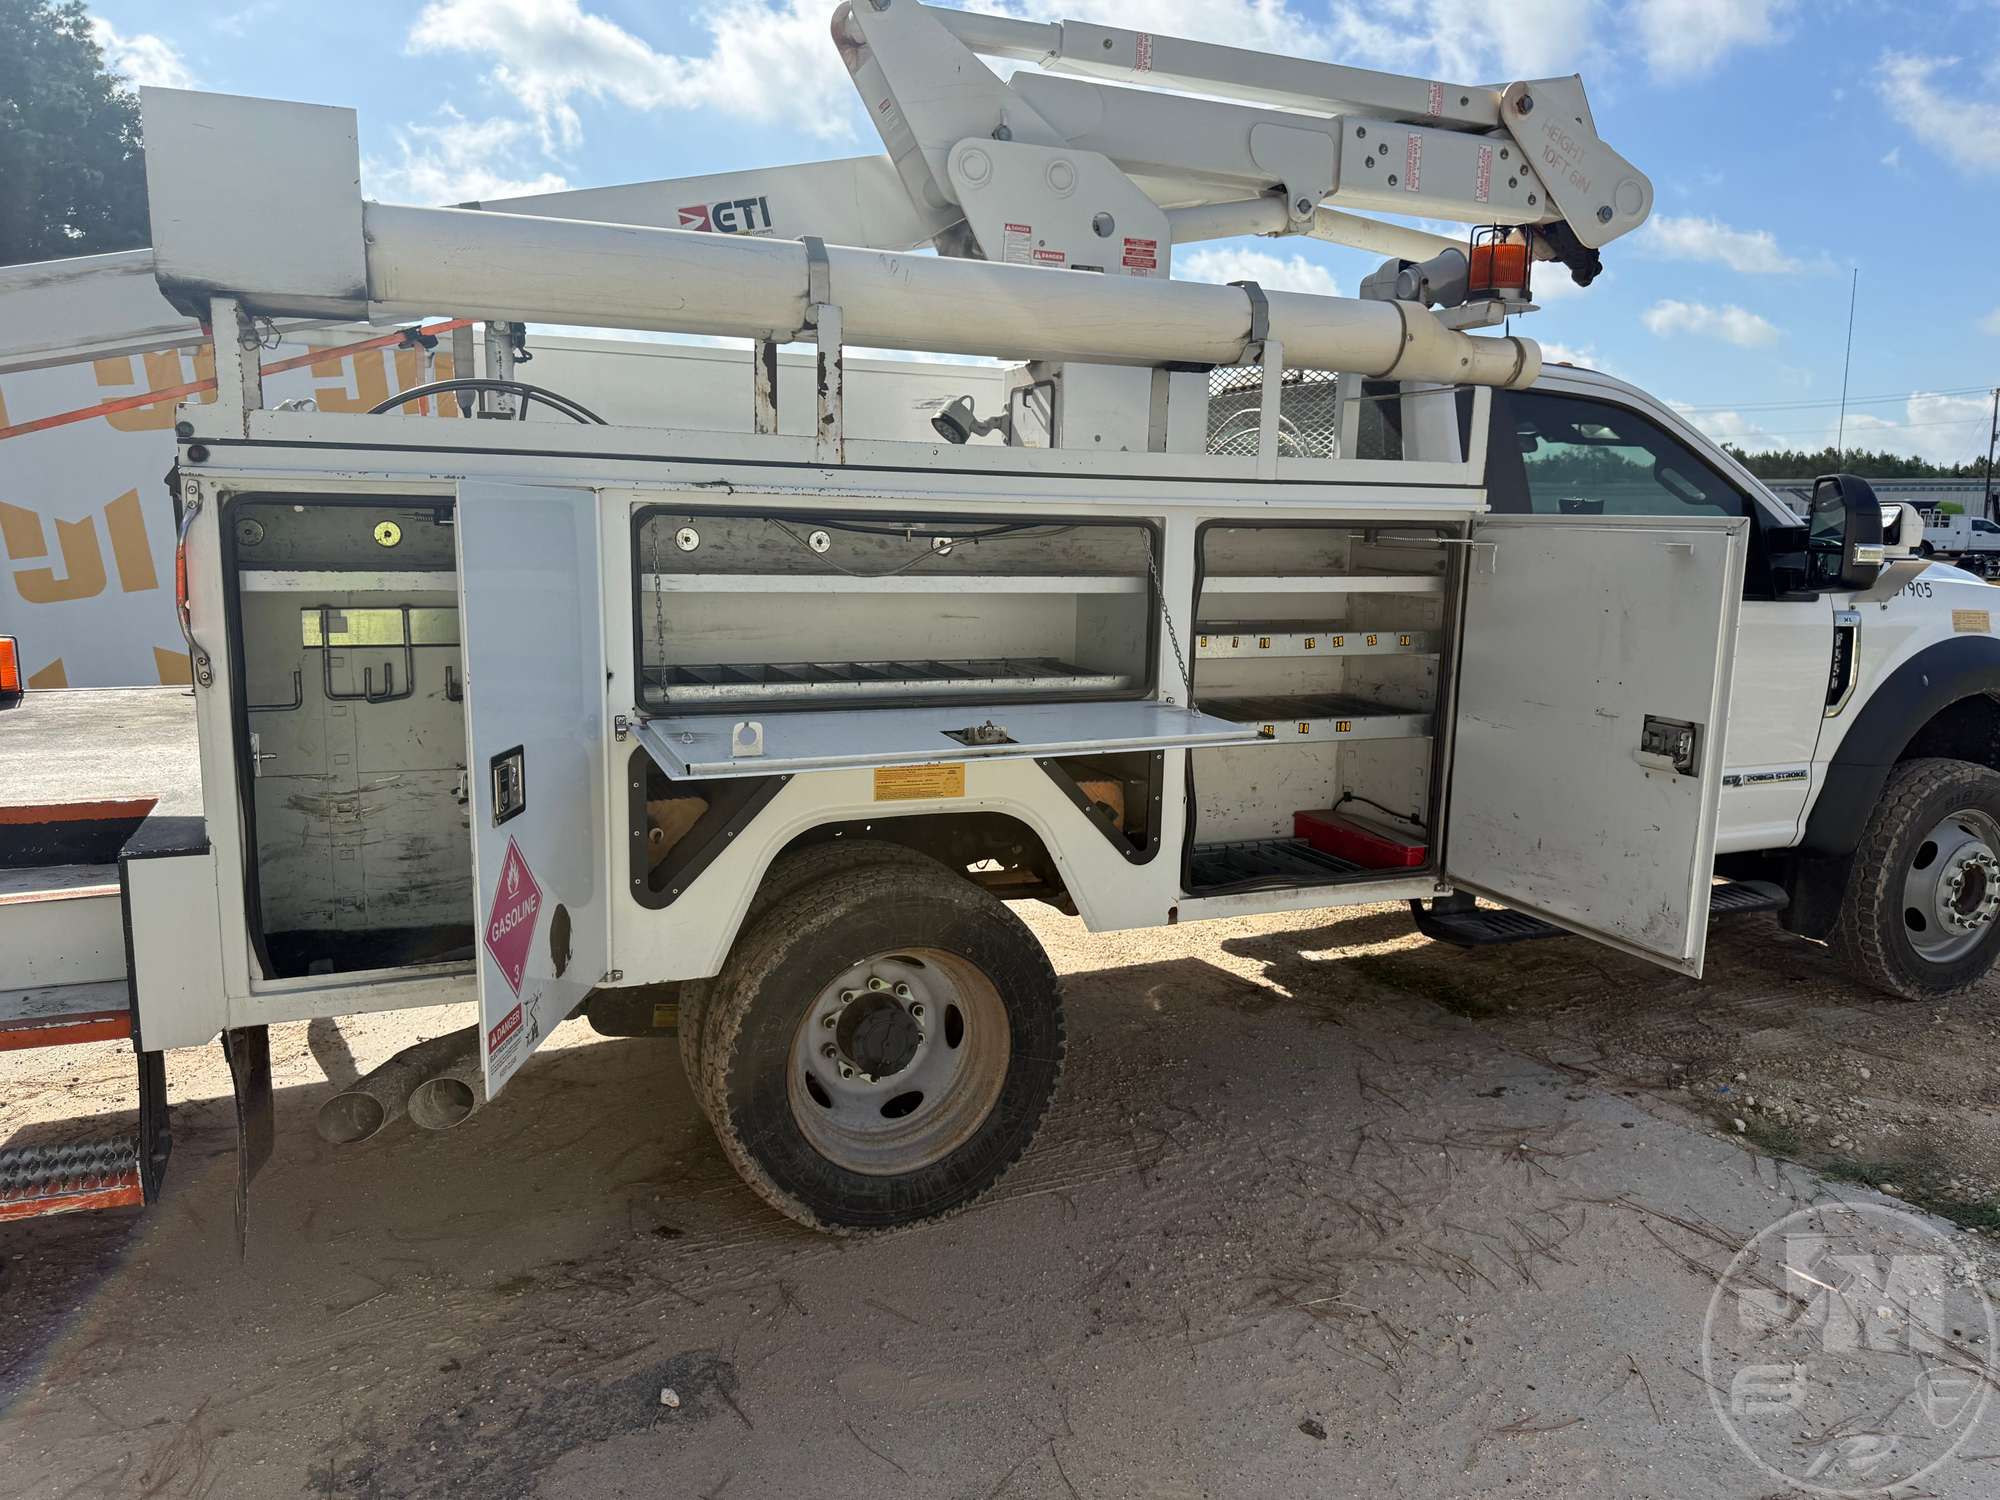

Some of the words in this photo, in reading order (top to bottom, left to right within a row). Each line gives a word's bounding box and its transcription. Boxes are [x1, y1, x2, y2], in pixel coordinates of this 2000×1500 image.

[712, 197, 771, 232] ETI
[1259, 637, 1270, 648] 10
[1304, 638, 1315, 649] 15
[1333, 636, 1344, 648] 20
[1367, 635, 1377, 646] 25
[1400, 635, 1410, 646] 30
[1336, 721, 1351, 732] 100
[491, 894, 537, 942] GASOLINE
[513, 964, 521, 985] 3
[496, 1010, 520, 1038] DANGER
